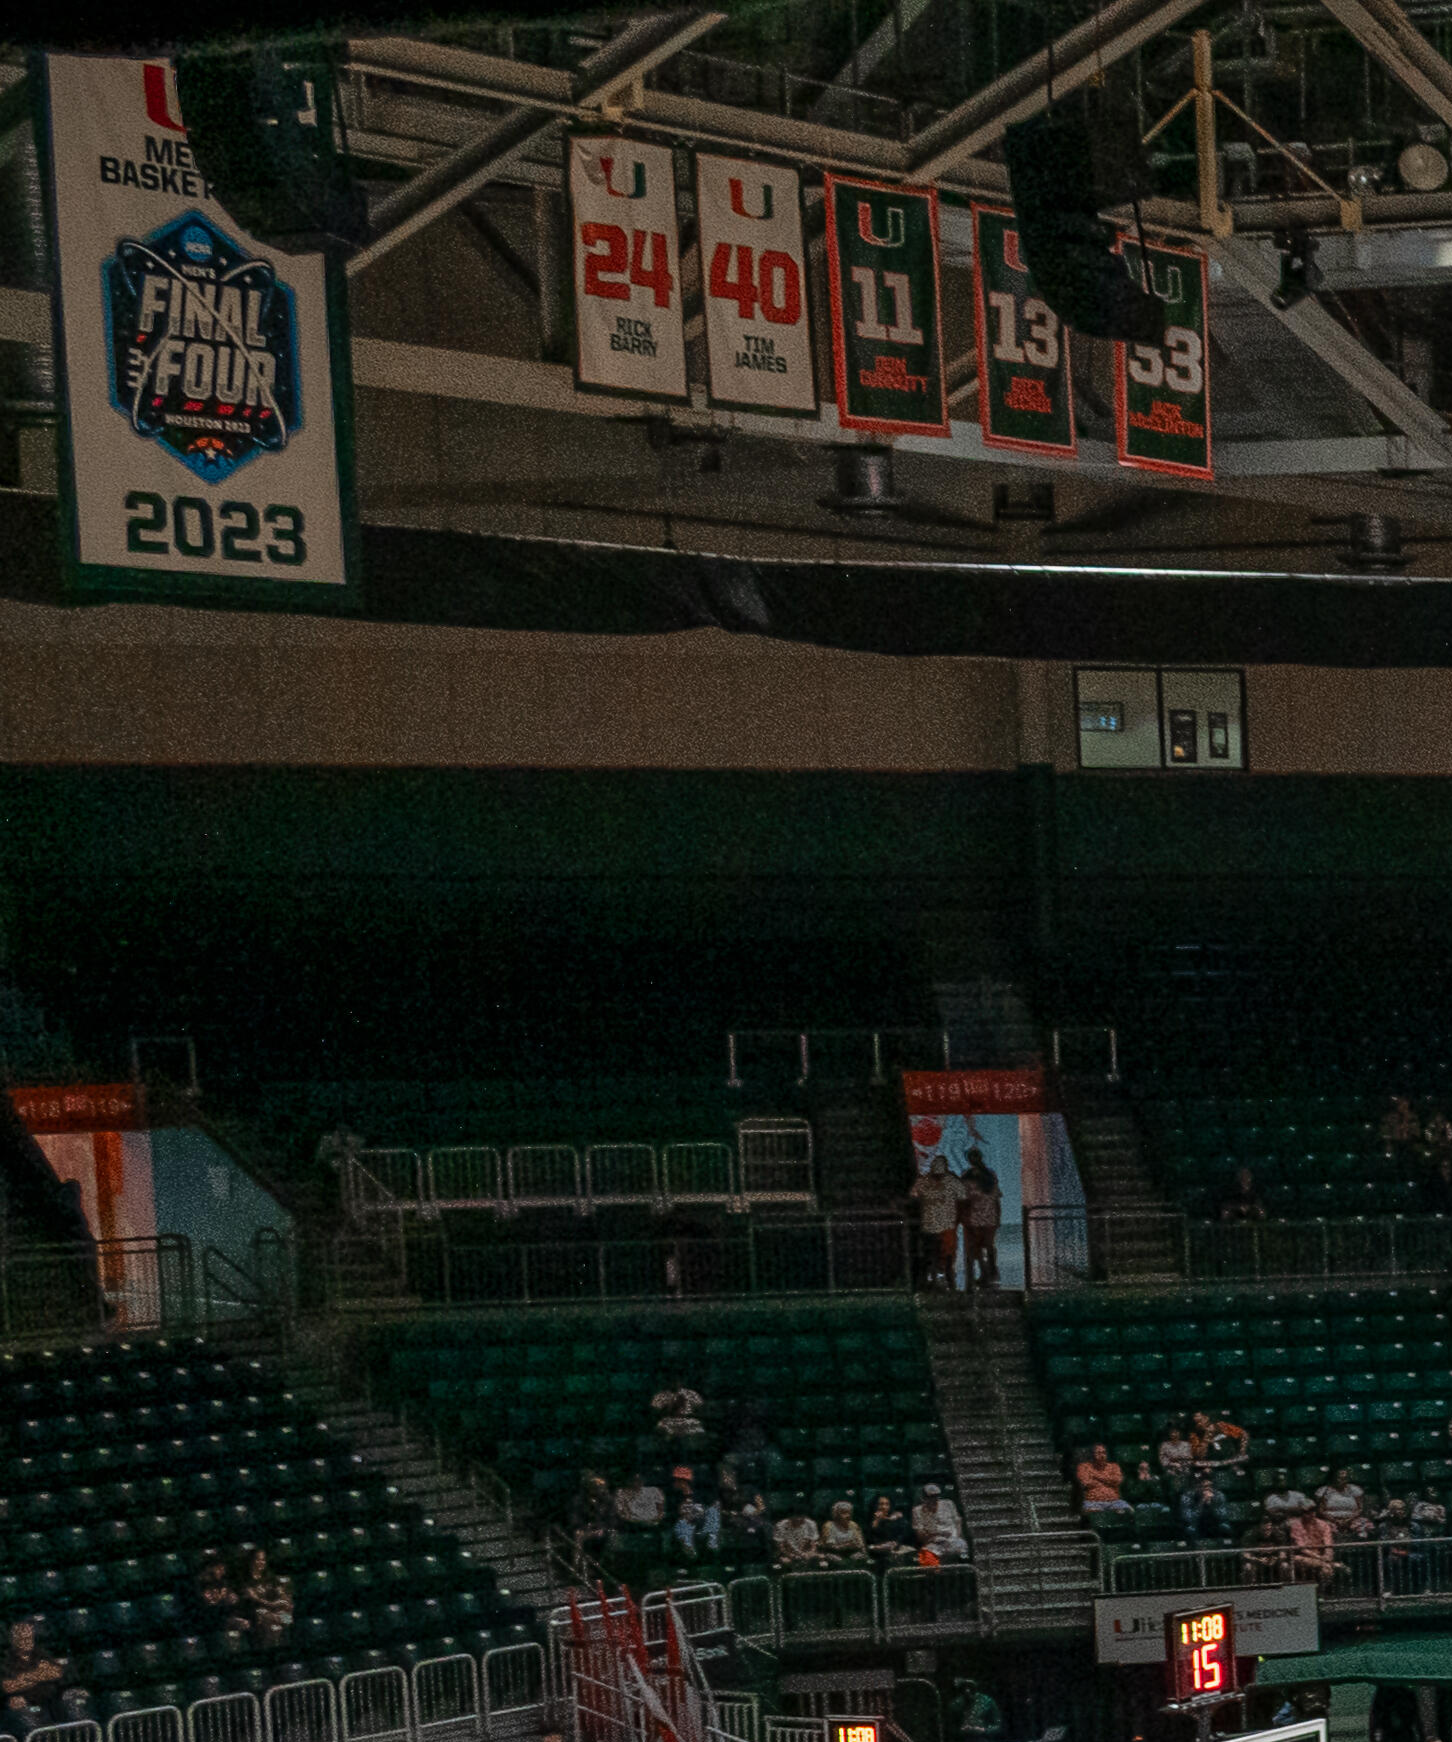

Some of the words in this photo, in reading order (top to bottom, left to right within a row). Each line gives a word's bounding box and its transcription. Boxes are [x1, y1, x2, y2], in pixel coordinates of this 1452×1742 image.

[582, 222, 673, 308] 24
[709, 243, 801, 325] 40
[139, 274, 267, 348] FINAL
[616, 317, 652, 341] RICK
[851, 266, 924, 345] 11
[989, 290, 1060, 369] 13
[153, 338, 277, 408] FOUR
[610, 337, 657, 358] BARRY
[735, 351, 787, 374] JAMES
[744, 335, 774, 354] TIM
[125, 490, 307, 566] 2023
[1181, 1613, 1225, 1645] 11:08
[1192, 1643, 1222, 1690] 15
